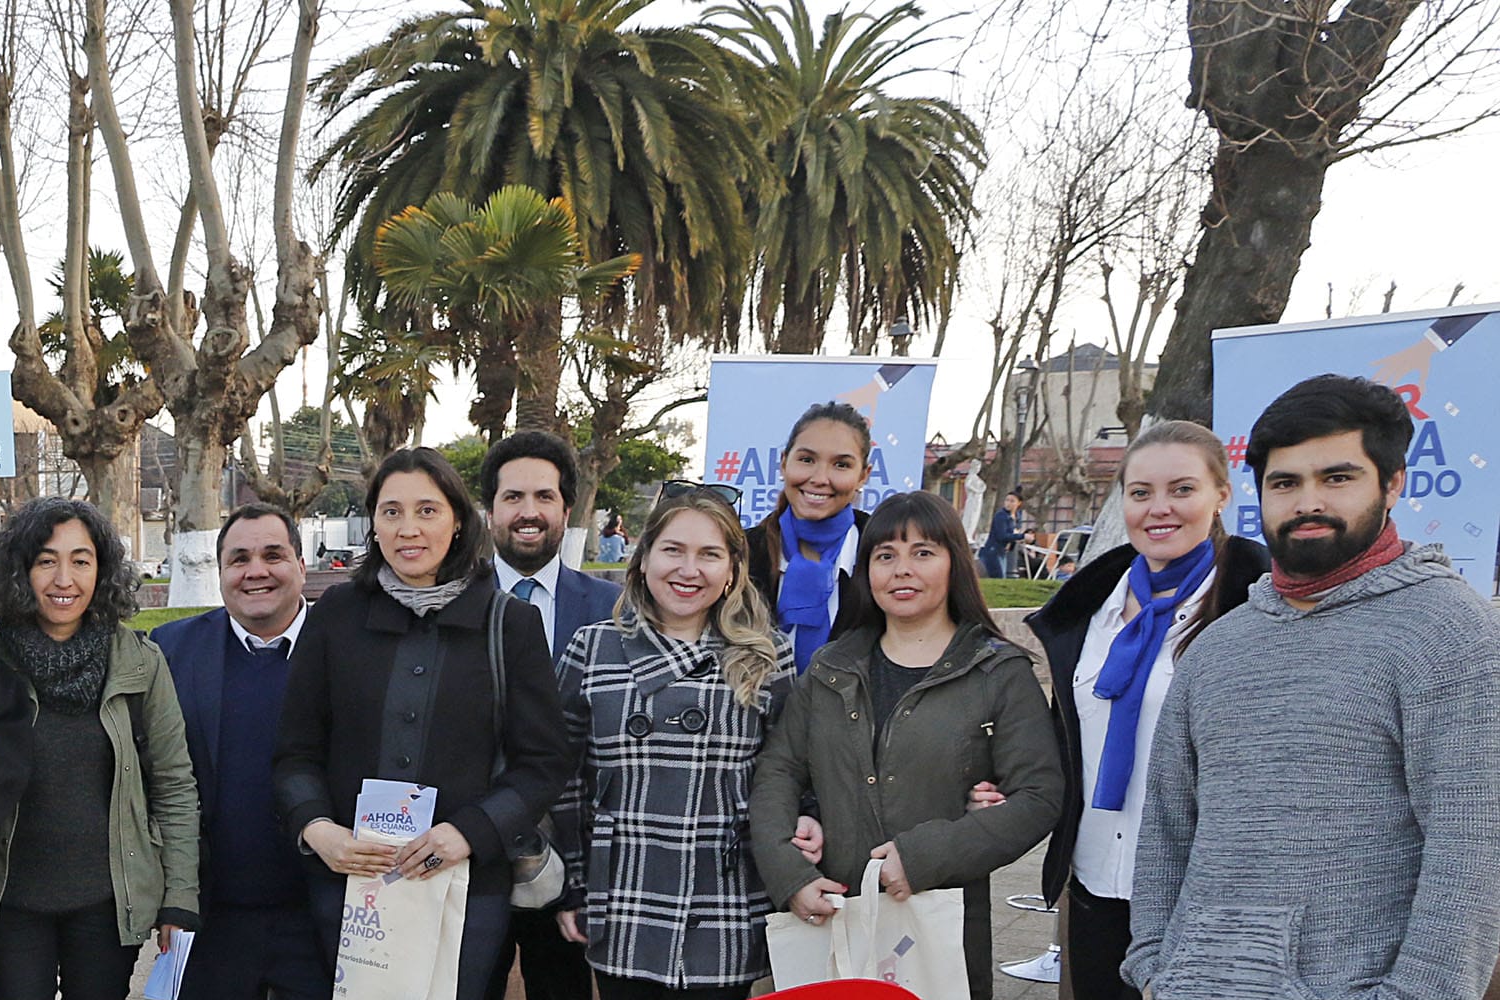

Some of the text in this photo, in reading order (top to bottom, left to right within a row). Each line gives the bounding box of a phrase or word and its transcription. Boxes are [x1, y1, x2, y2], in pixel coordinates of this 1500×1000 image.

[361, 813, 413, 825] #AHORA
[381, 823, 417, 833] CUANDO
[365, 895, 376, 910] R
